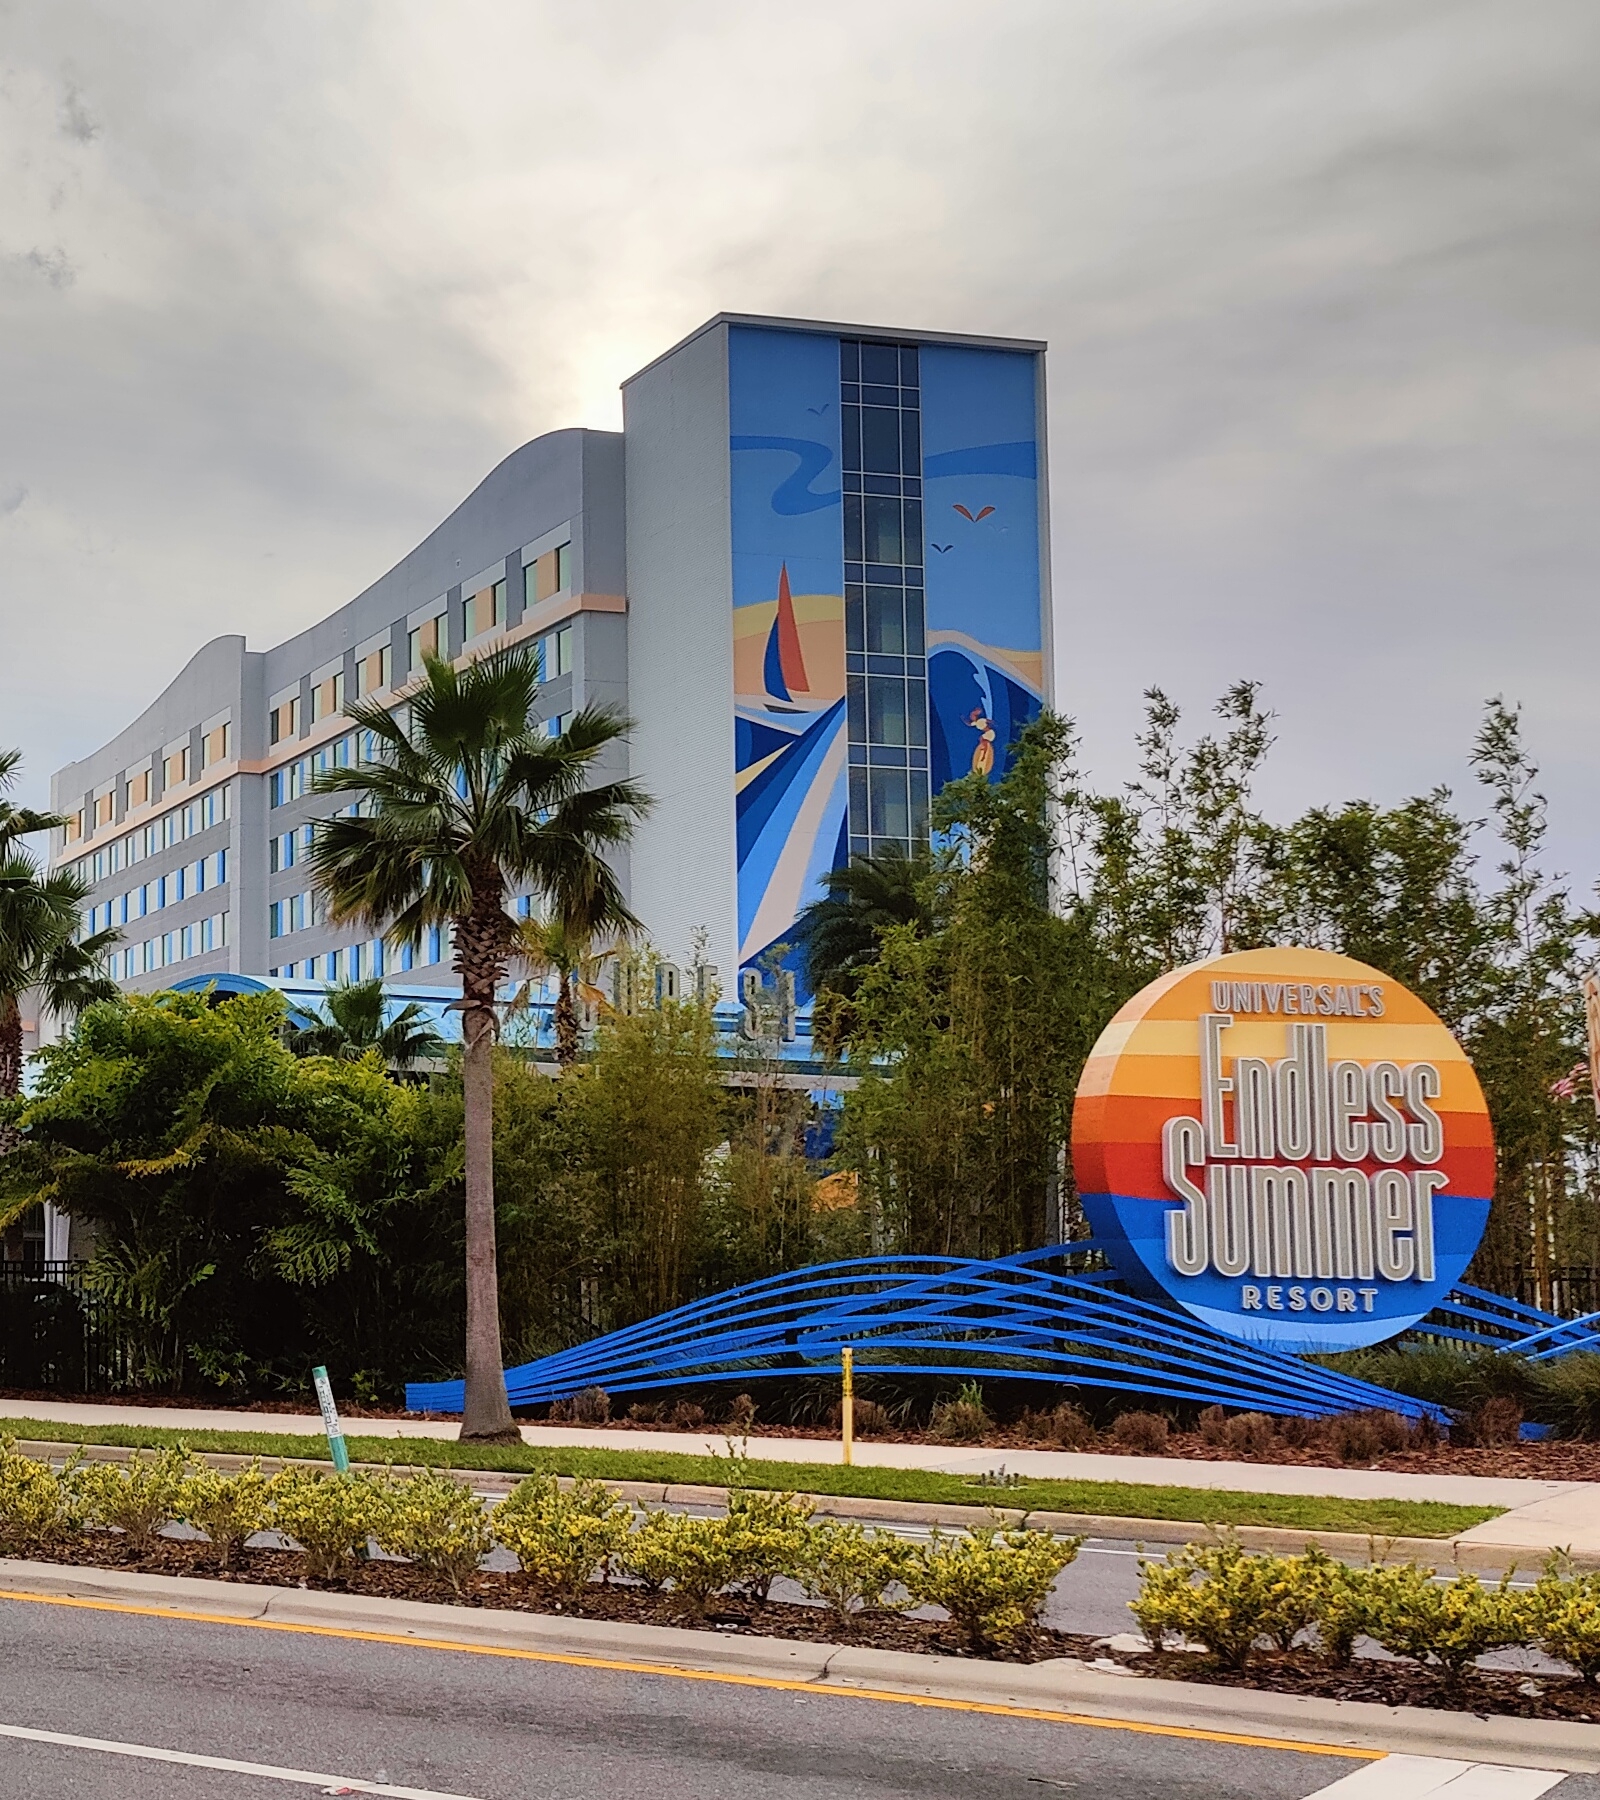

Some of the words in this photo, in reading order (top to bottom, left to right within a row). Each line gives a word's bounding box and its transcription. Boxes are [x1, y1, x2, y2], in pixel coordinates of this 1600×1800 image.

[1211, 981, 1385, 1017] UNIVERSAL'S
[1200, 1013, 1444, 1165] Endless
[1163, 1116, 1450, 1282] Summer
[1242, 1285, 1378, 1312] RESORT
